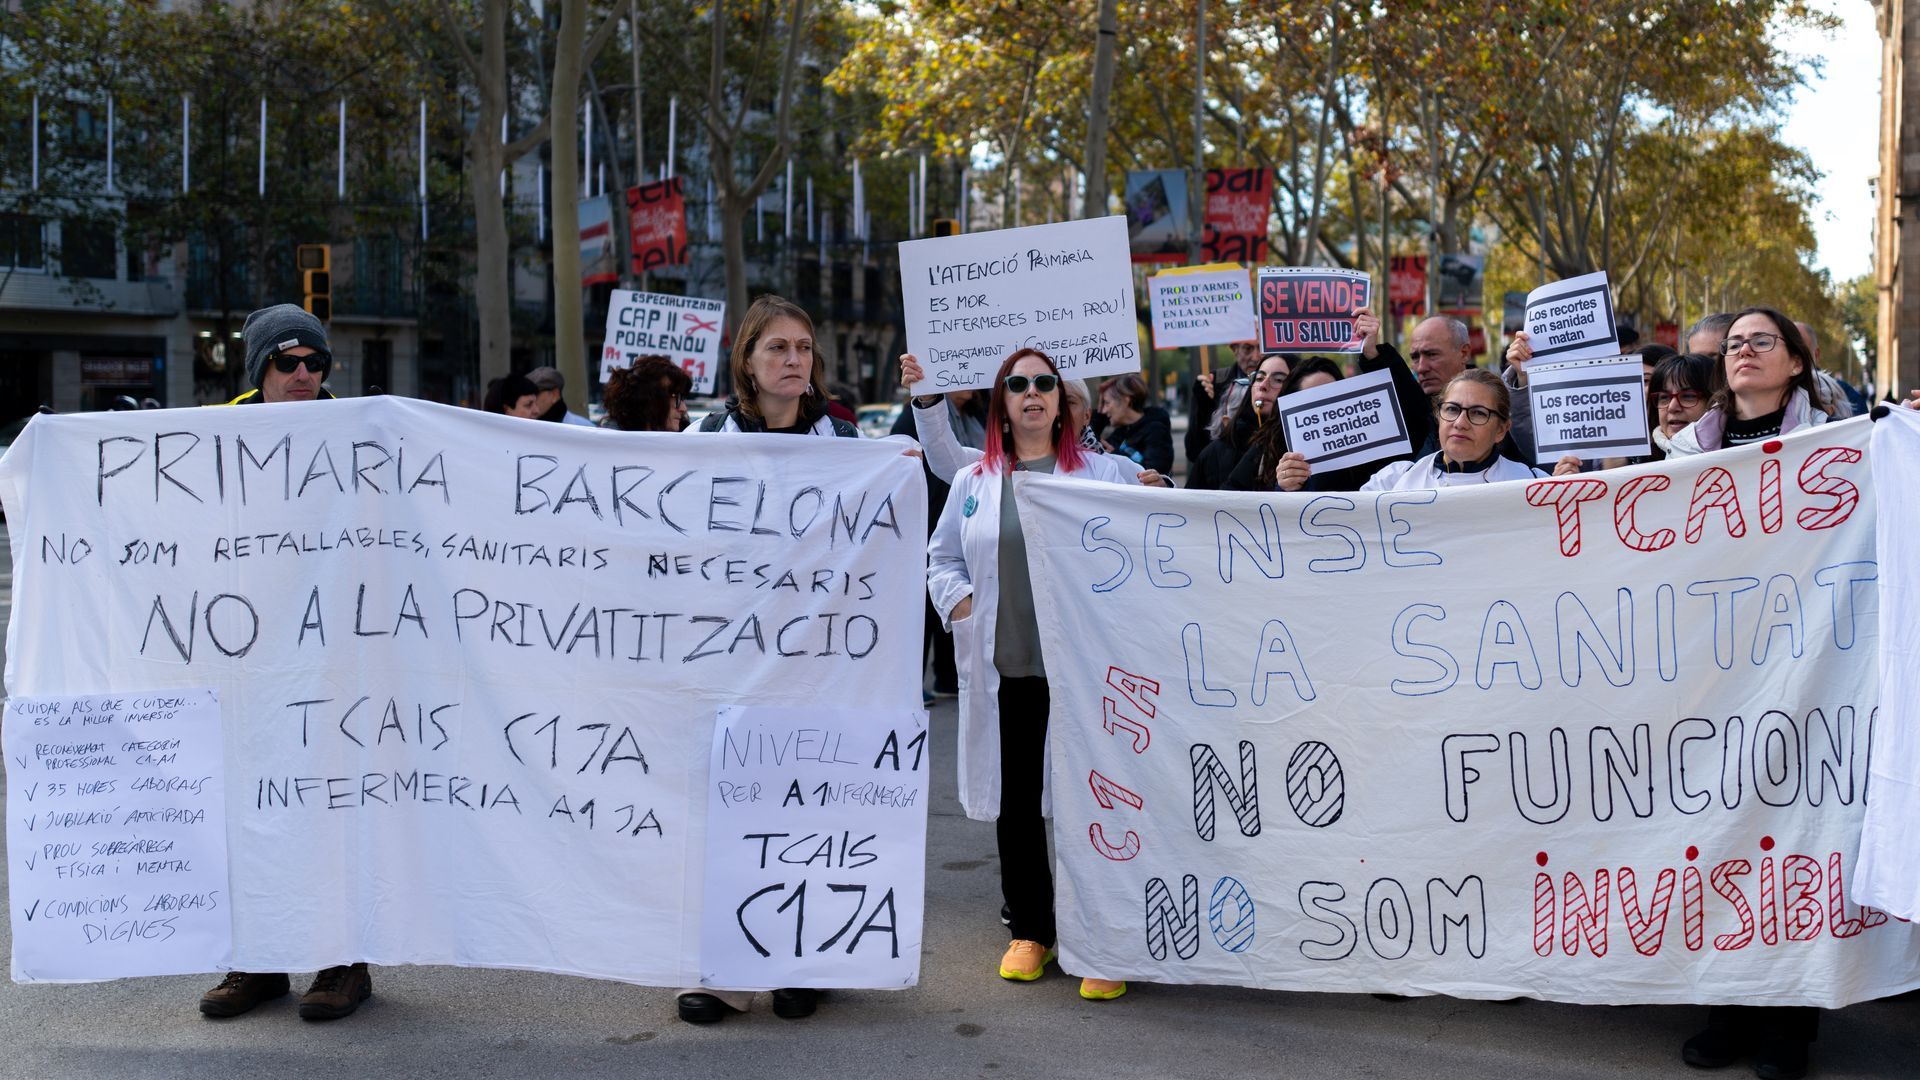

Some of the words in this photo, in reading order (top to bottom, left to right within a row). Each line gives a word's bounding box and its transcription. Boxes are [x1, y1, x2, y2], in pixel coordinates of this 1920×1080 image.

[1160, 286, 1188, 295] PROU
[1191, 281, 1239, 293] D'ARMES
[1168, 296, 1190, 306] MÉS
[1192, 290, 1242, 304] INVERSIÓ
[1263, 281, 1289, 315] SE
[1293, 281, 1364, 313] VENDE
[930, 297, 949, 312] ES
[1163, 310, 1176, 318] EN
[1179, 308, 1193, 317] LA
[1195, 305, 1229, 316] SALUT
[1528, 310, 1547, 322] Los
[1550, 299, 1597, 317] recortes
[619, 307, 660, 329] CAP
[928, 313, 1027, 334] INFERMERES
[1036, 308, 1073, 323] DIEM
[1164, 318, 1210, 330] PÚBLICA
[1533, 324, 1547, 335] en
[1549, 311, 1595, 332] sanidad
[616, 330, 706, 353] POBLENOU
[1274, 322, 1295, 343] TU
[1299, 321, 1352, 344] SALUD
[1549, 330, 1585, 346] matan
[959, 362, 969, 370] DE
[936, 370, 985, 387] SALUT
[1540, 395, 1562, 409] Los
[1566, 389, 1631, 407] recortes
[1294, 414, 1319, 428] Los
[1322, 398, 1381, 422] recortes
[1546, 413, 1560, 425] en
[1563, 404, 1626, 423] sanidad
[1302, 429, 1320, 441] en
[1323, 411, 1380, 437] sanidad
[1560, 425, 1608, 440] matan
[1322, 432, 1368, 452] matan
[515, 454, 903, 550] BARCELONA
[1081, 489, 1443, 594] SENSE
[41, 534, 93, 565] NO
[118, 538, 179, 567] SOM
[442, 532, 610, 570] SANITARIS
[648, 552, 877, 601] NECESARIS
[140, 589, 260, 665] NO
[298, 584, 326, 647] A
[354, 583, 429, 639] LA
[454, 587, 879, 664] PRIVATITZACIO
[1181, 618, 1317, 708] LA
[1390, 560, 1880, 697] SANITAT
[71, 700, 93, 714] ALS
[100, 699, 125, 712] QUE
[34, 717, 50, 726] ES
[58, 716, 72, 726] LA
[286, 696, 460, 751] TCAIS
[873, 729, 928, 771] A1
[1189, 740, 1345, 842] NO
[1441, 704, 1880, 825] FUNCION
[48, 782, 68, 797] 35
[77, 780, 118, 796] HORES
[130, 776, 212, 796] LABORALS
[257, 768, 522, 816] INFERMERIA
[718, 780, 762, 808] PER
[43, 842, 82, 860] PROU
[742, 830, 878, 869] TCAIS
[137, 859, 193, 875] MENTAL
[143, 890, 219, 912] LABORALS
[1144, 873, 1256, 962] NO
[1299, 875, 1487, 962] SOM
